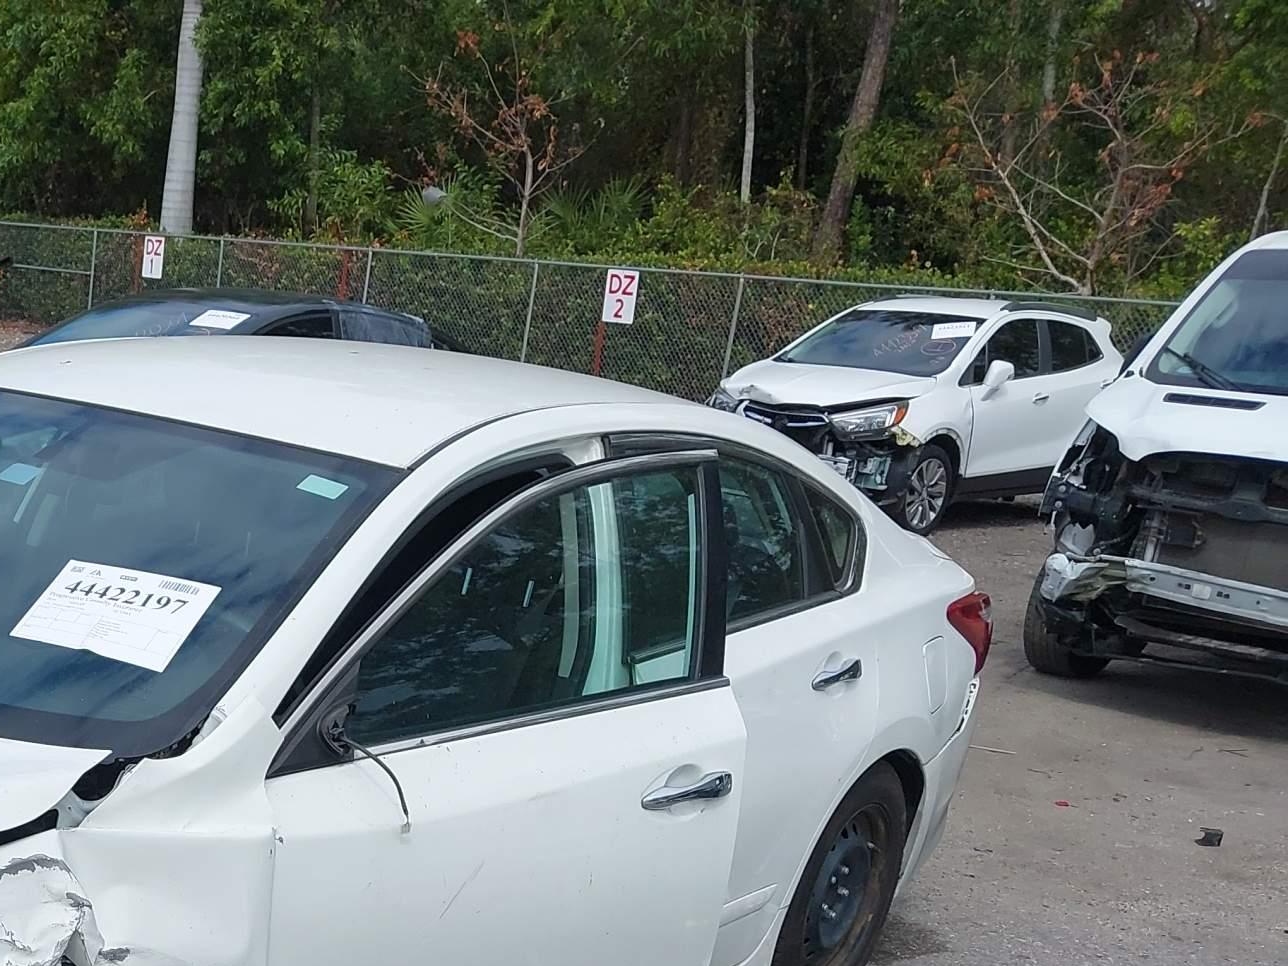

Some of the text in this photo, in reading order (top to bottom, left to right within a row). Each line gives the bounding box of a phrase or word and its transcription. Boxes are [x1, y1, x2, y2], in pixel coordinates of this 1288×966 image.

[146, 238, 163, 256] DZ
[609, 273, 636, 296] DZ
[613, 298, 624, 318] 2
[64, 579, 190, 615] 44422197
